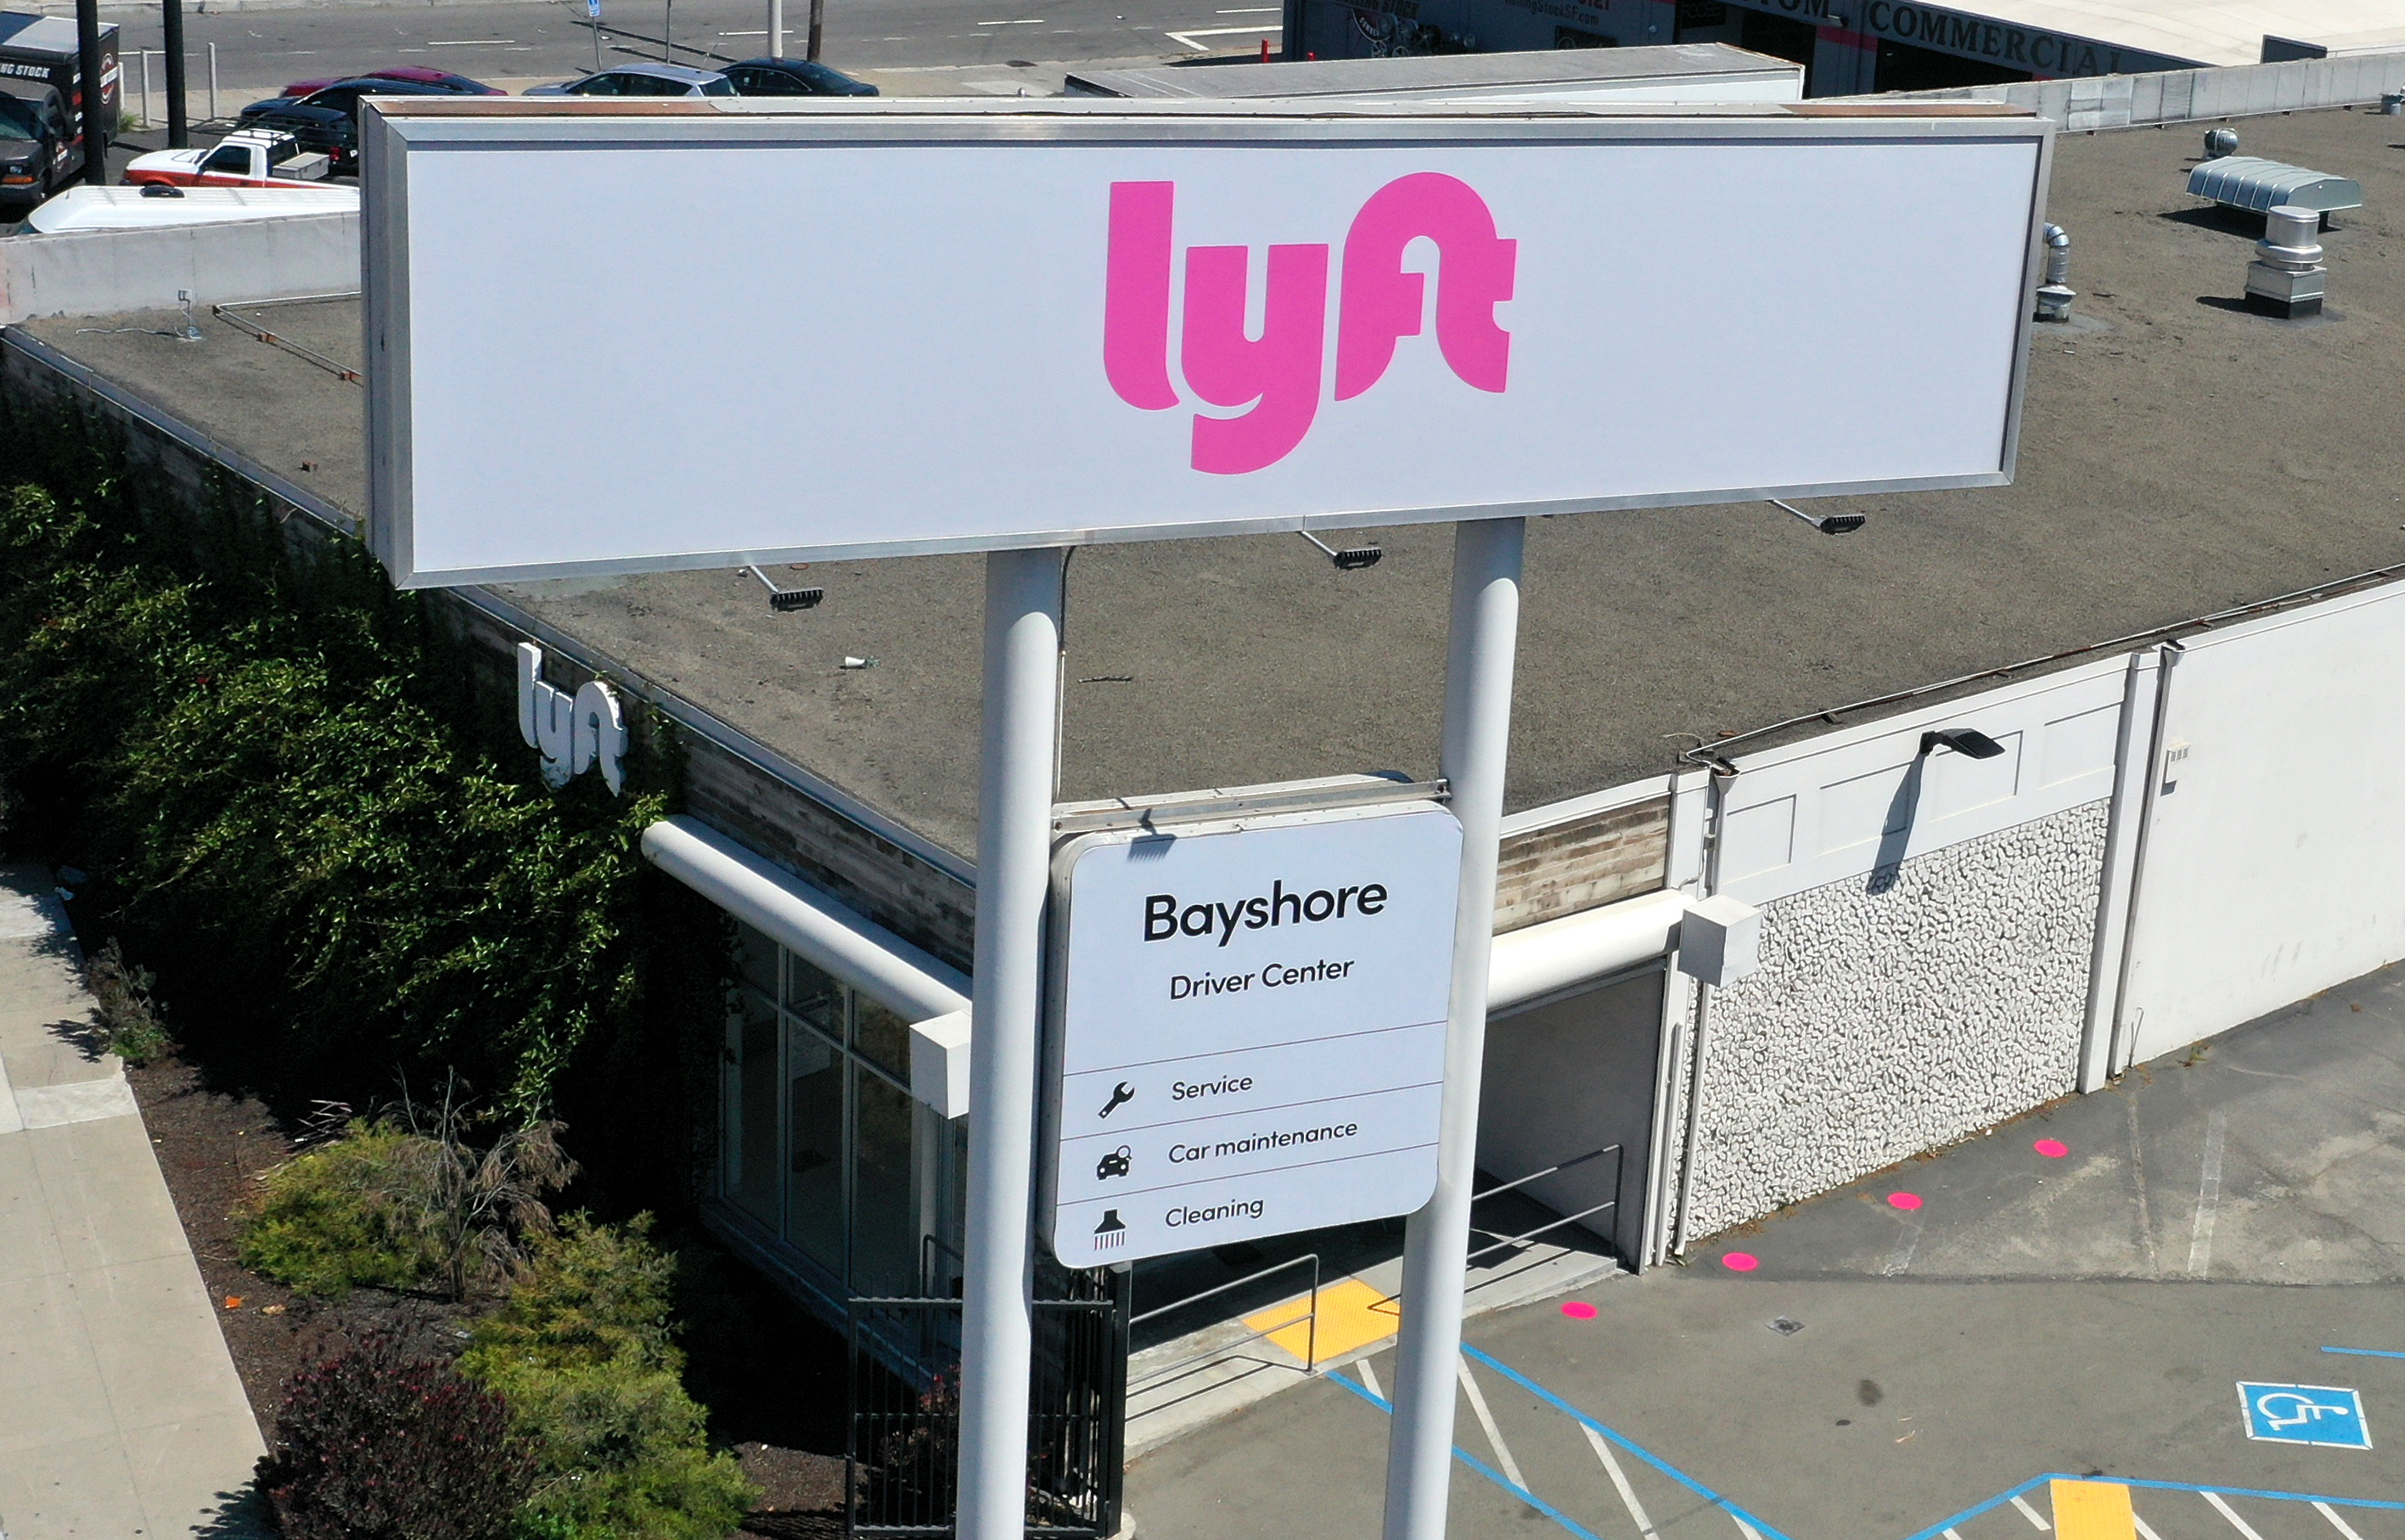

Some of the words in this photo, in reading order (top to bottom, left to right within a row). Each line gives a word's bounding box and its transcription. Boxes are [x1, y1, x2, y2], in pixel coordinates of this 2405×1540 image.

[15, 65, 50, 78] STOCK
[1104, 171, 1517, 475] lyft
[518, 642, 628, 798] lyft
[1143, 880, 1388, 947] Bayshore
[1171, 971, 1256, 1000] Driver
[1262, 958, 1355, 987] Center
[1172, 1076, 1254, 1101] Service
[1168, 1144, 1211, 1164] Car
[1215, 1122, 1358, 1157] maintenance
[1166, 1199, 1265, 1228] Cleaning
